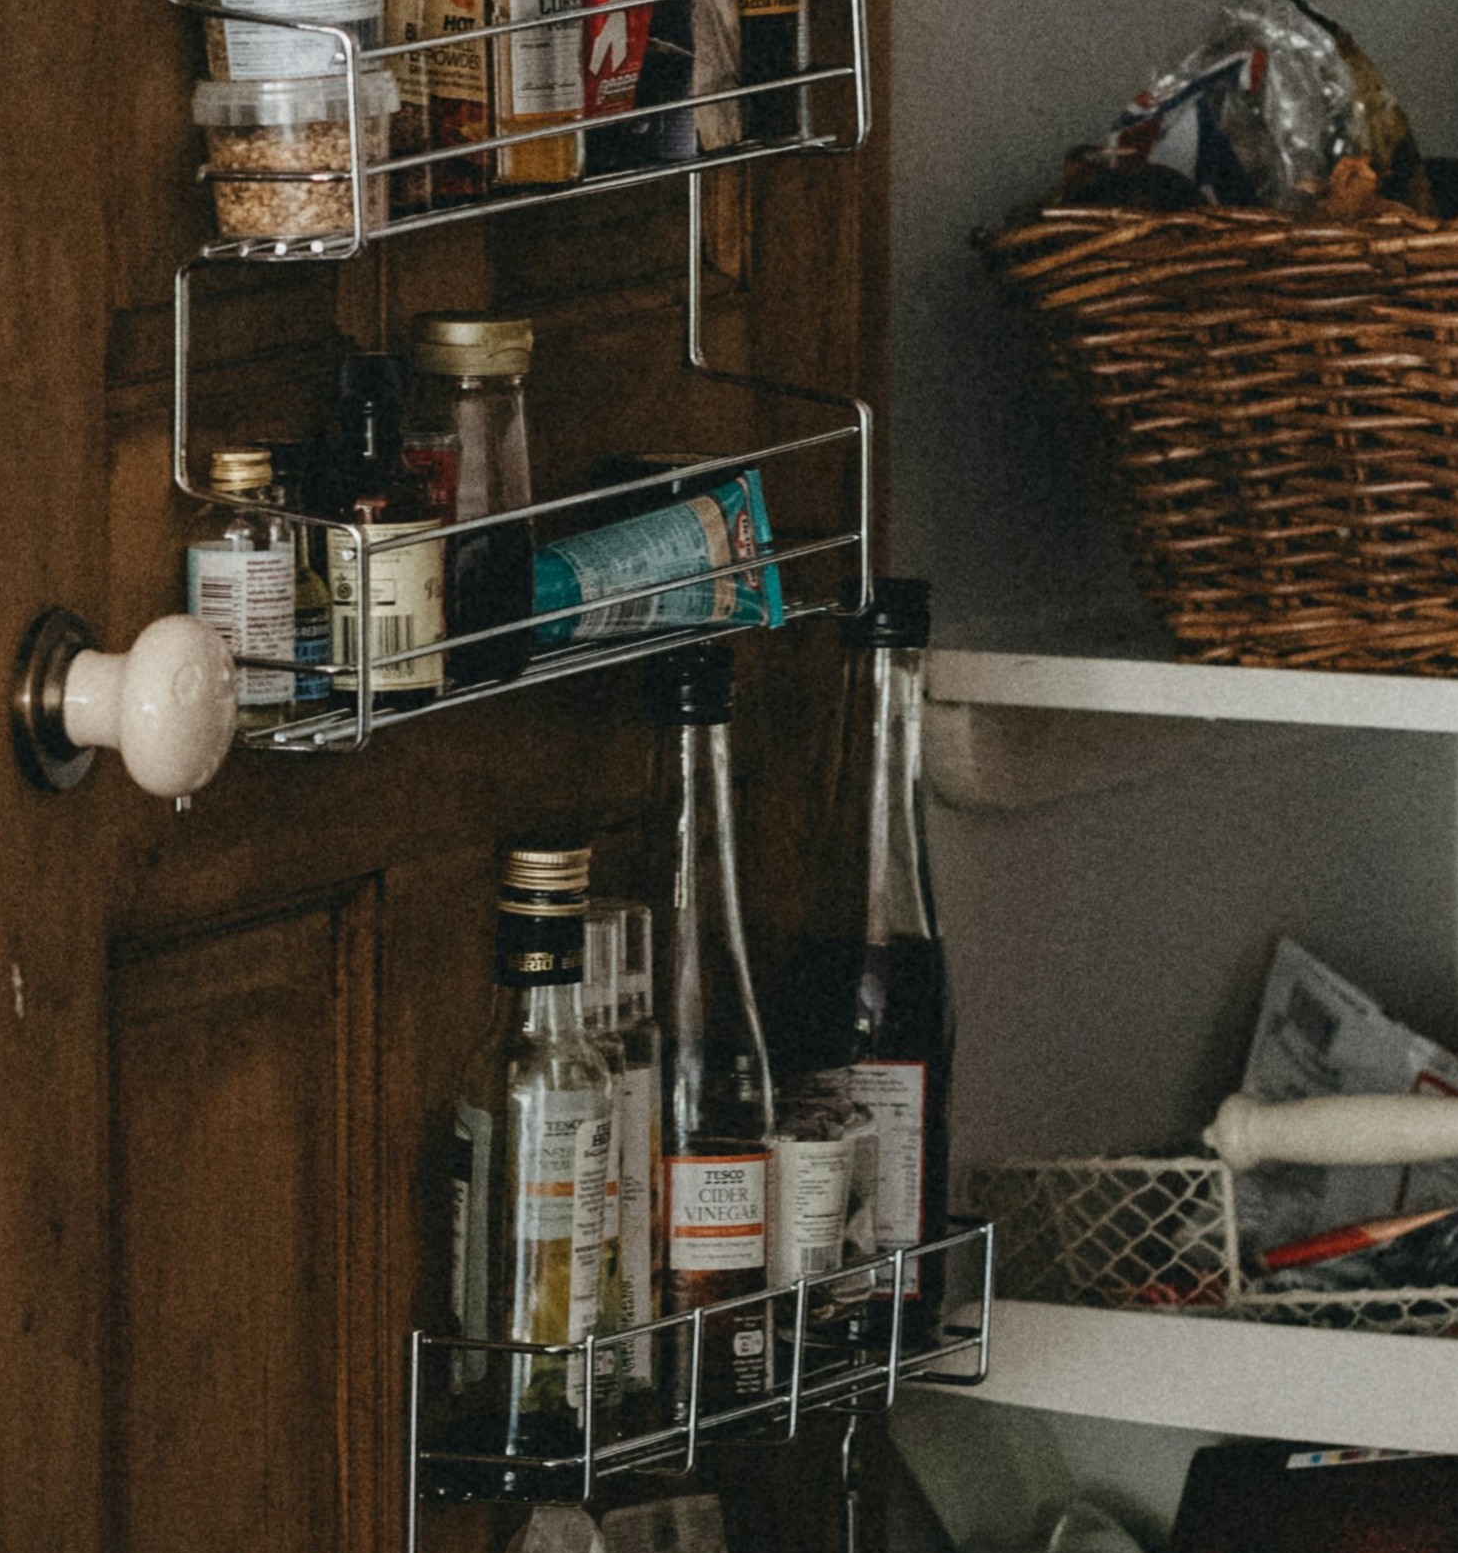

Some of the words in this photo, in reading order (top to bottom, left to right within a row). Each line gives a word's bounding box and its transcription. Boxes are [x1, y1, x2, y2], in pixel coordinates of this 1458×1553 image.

[443, 14, 476, 32] HOT
[704, 1170, 745, 1182] TESCO
[698, 1188, 750, 1205] CIDER
[683, 1204, 759, 1222] VINEGAR
